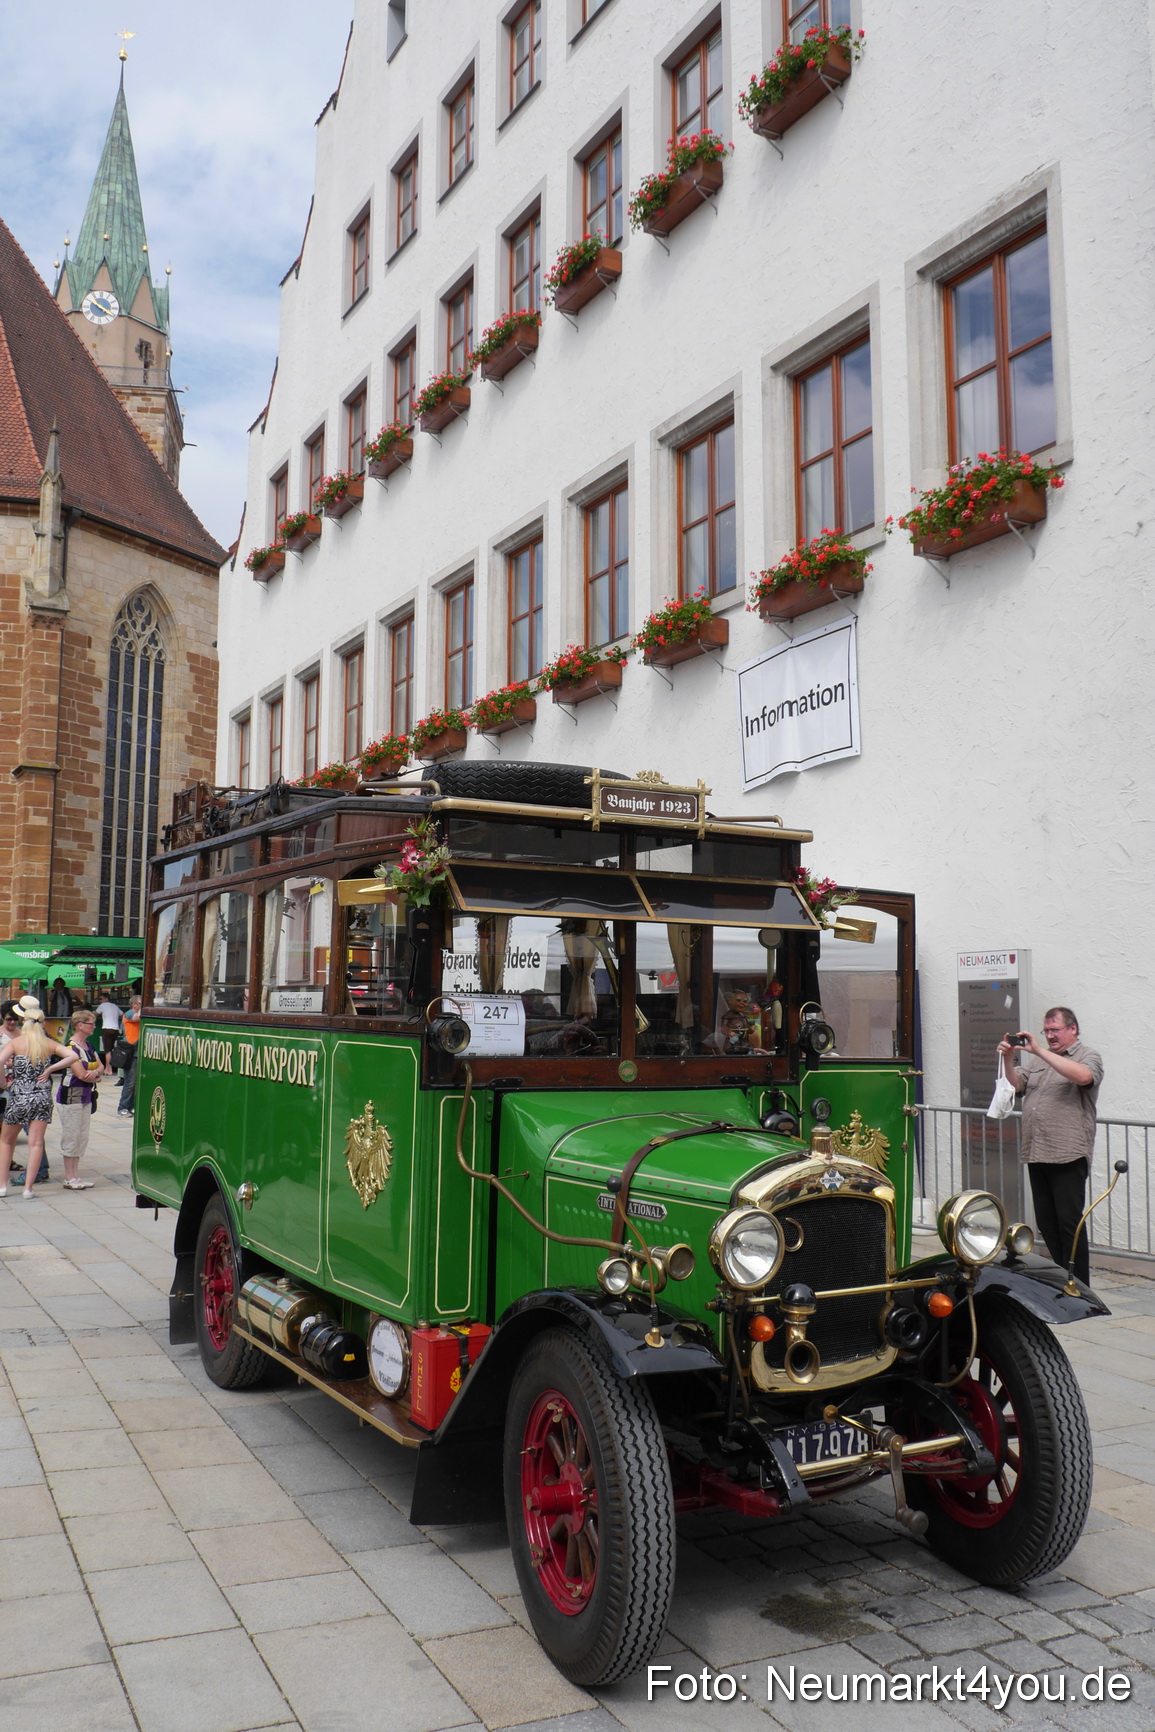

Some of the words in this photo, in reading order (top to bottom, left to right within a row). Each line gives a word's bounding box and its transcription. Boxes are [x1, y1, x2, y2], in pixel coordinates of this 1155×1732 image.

[744, 681, 846, 739] Information
[606, 793, 656, 813] Baujahr
[659, 799, 692, 814] 1923
[959, 954, 1007, 967] NEUMARKT
[482, 1005, 509, 1020] 247
[143, 1031, 193, 1066] JOHNSTON'S
[195, 1037, 233, 1074] MOTOR
[238, 1042, 319, 1087] TRANSPORT
[600, 1196, 662, 1218] INTATIONAL
[416, 1352, 424, 1411] SHELL
